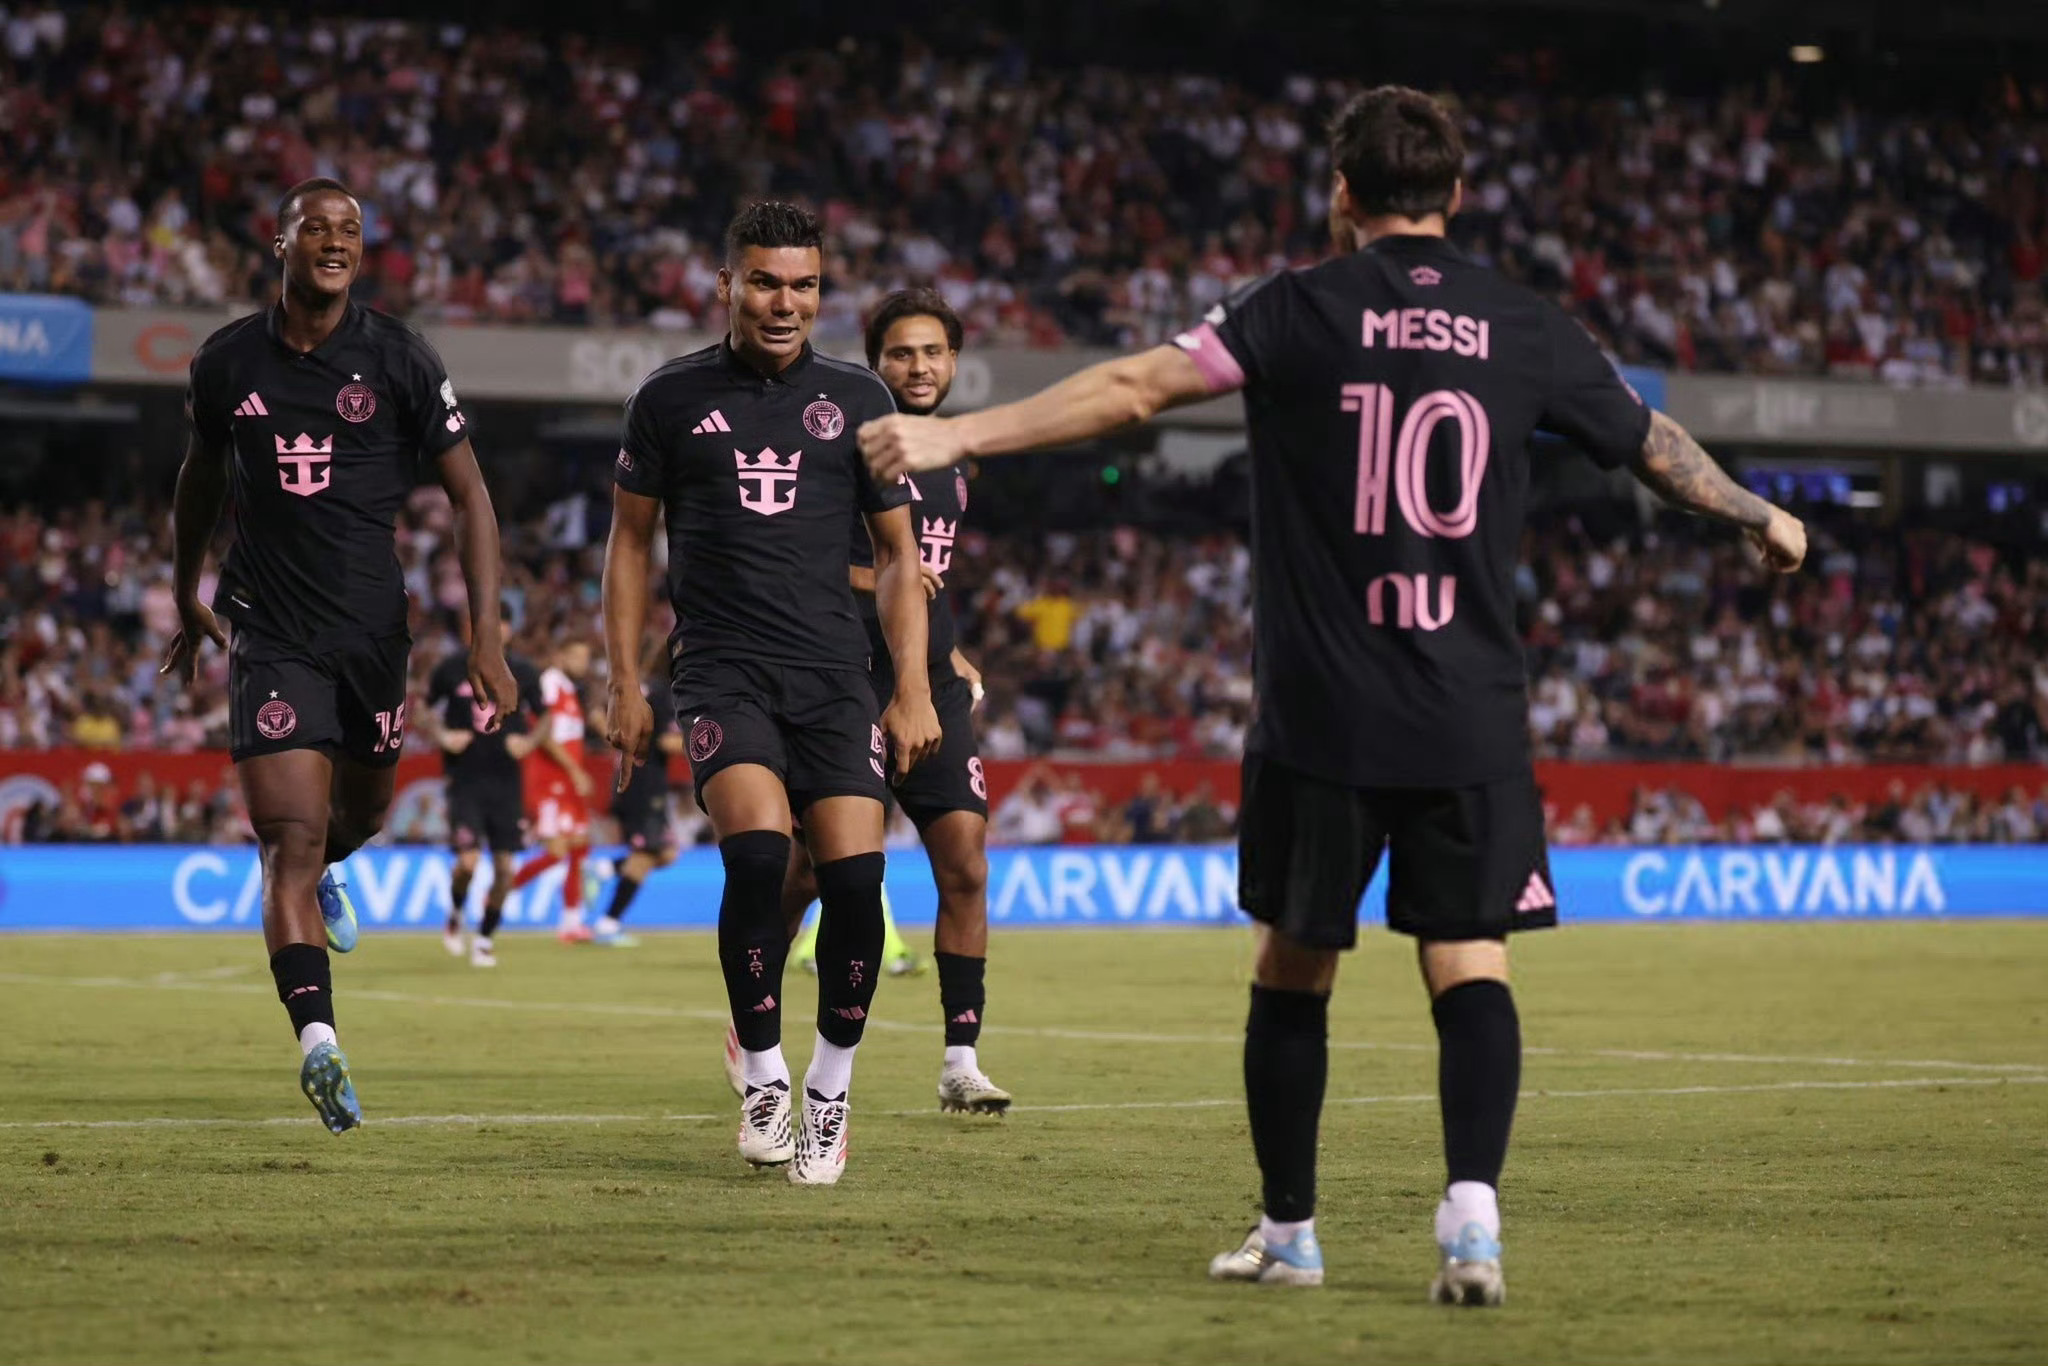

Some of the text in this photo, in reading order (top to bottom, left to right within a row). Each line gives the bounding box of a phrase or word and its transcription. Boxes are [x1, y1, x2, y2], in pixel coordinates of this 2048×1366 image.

[1361, 307, 1489, 360] MESSI
[1340, 383, 1490, 539] 10
[373, 701, 405, 753] 15
[967, 756, 988, 801] 8
[1621, 850, 1947, 915] CARVANA
